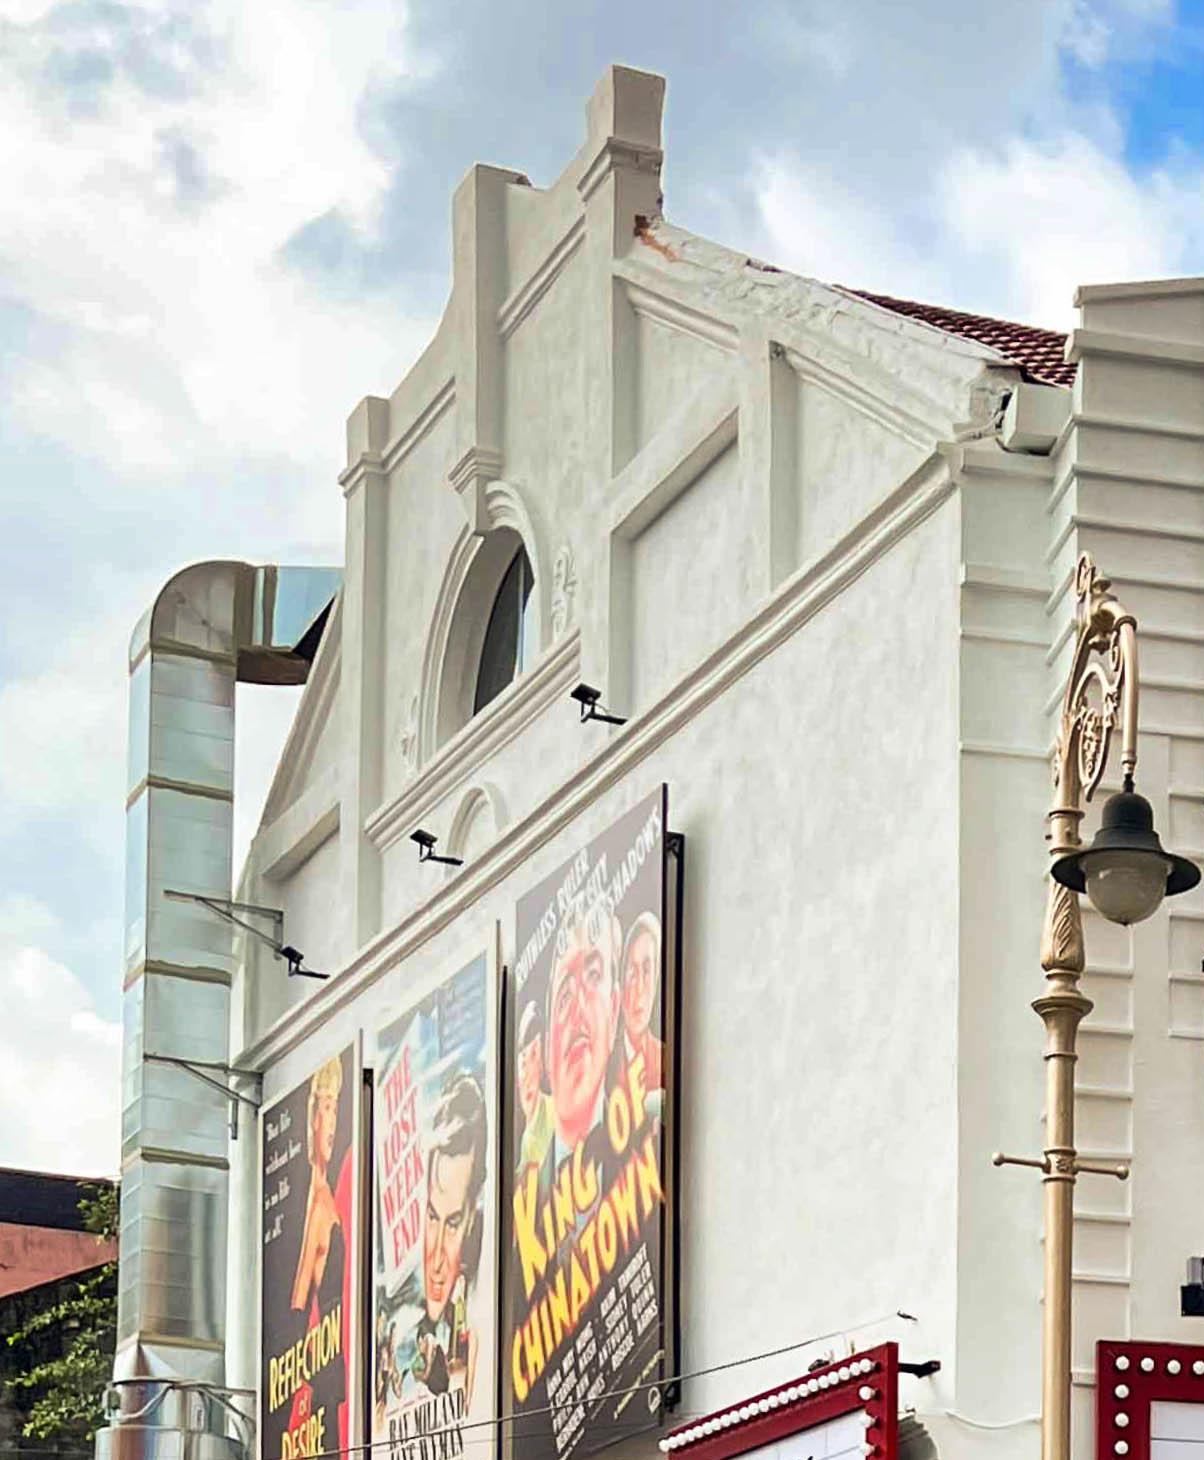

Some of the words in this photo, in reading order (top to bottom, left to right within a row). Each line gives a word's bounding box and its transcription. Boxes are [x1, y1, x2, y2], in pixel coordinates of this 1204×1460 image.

[511, 1136, 666, 1402] CHINATOWN
[512, 1138, 597, 1299] KING
[608, 1050, 648, 1154] OF
[269, 1304, 341, 1414] REFLECTION
